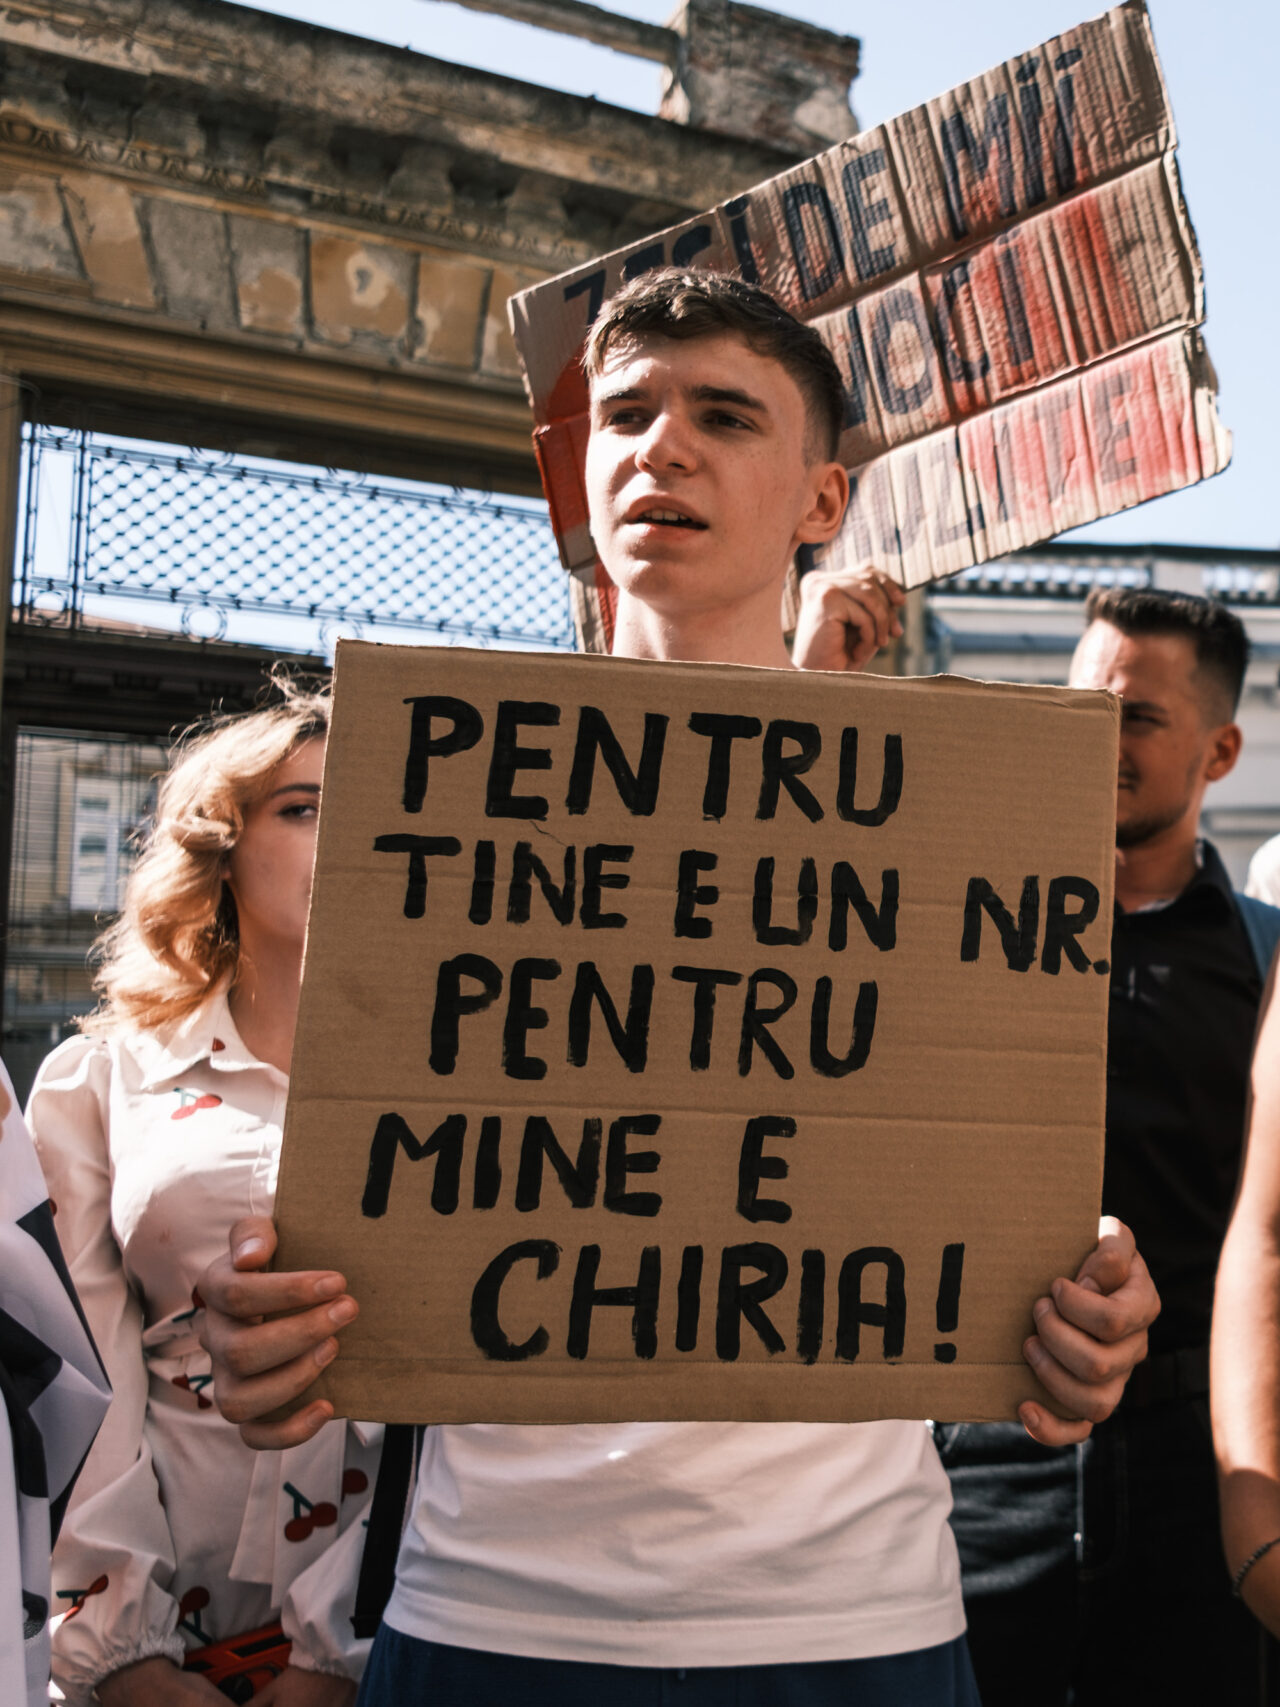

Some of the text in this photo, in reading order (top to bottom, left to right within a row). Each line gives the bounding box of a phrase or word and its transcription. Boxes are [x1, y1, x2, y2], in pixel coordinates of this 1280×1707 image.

[783, 150, 896, 302] DE
[402, 695, 904, 827] PENTRU
[373, 833, 1111, 976] TINE E UN NR.
[428, 953, 879, 1080] PENTRU
[361, 1112, 798, 1224] MINE E
[470, 1239, 966, 1365] CHIRIA!
